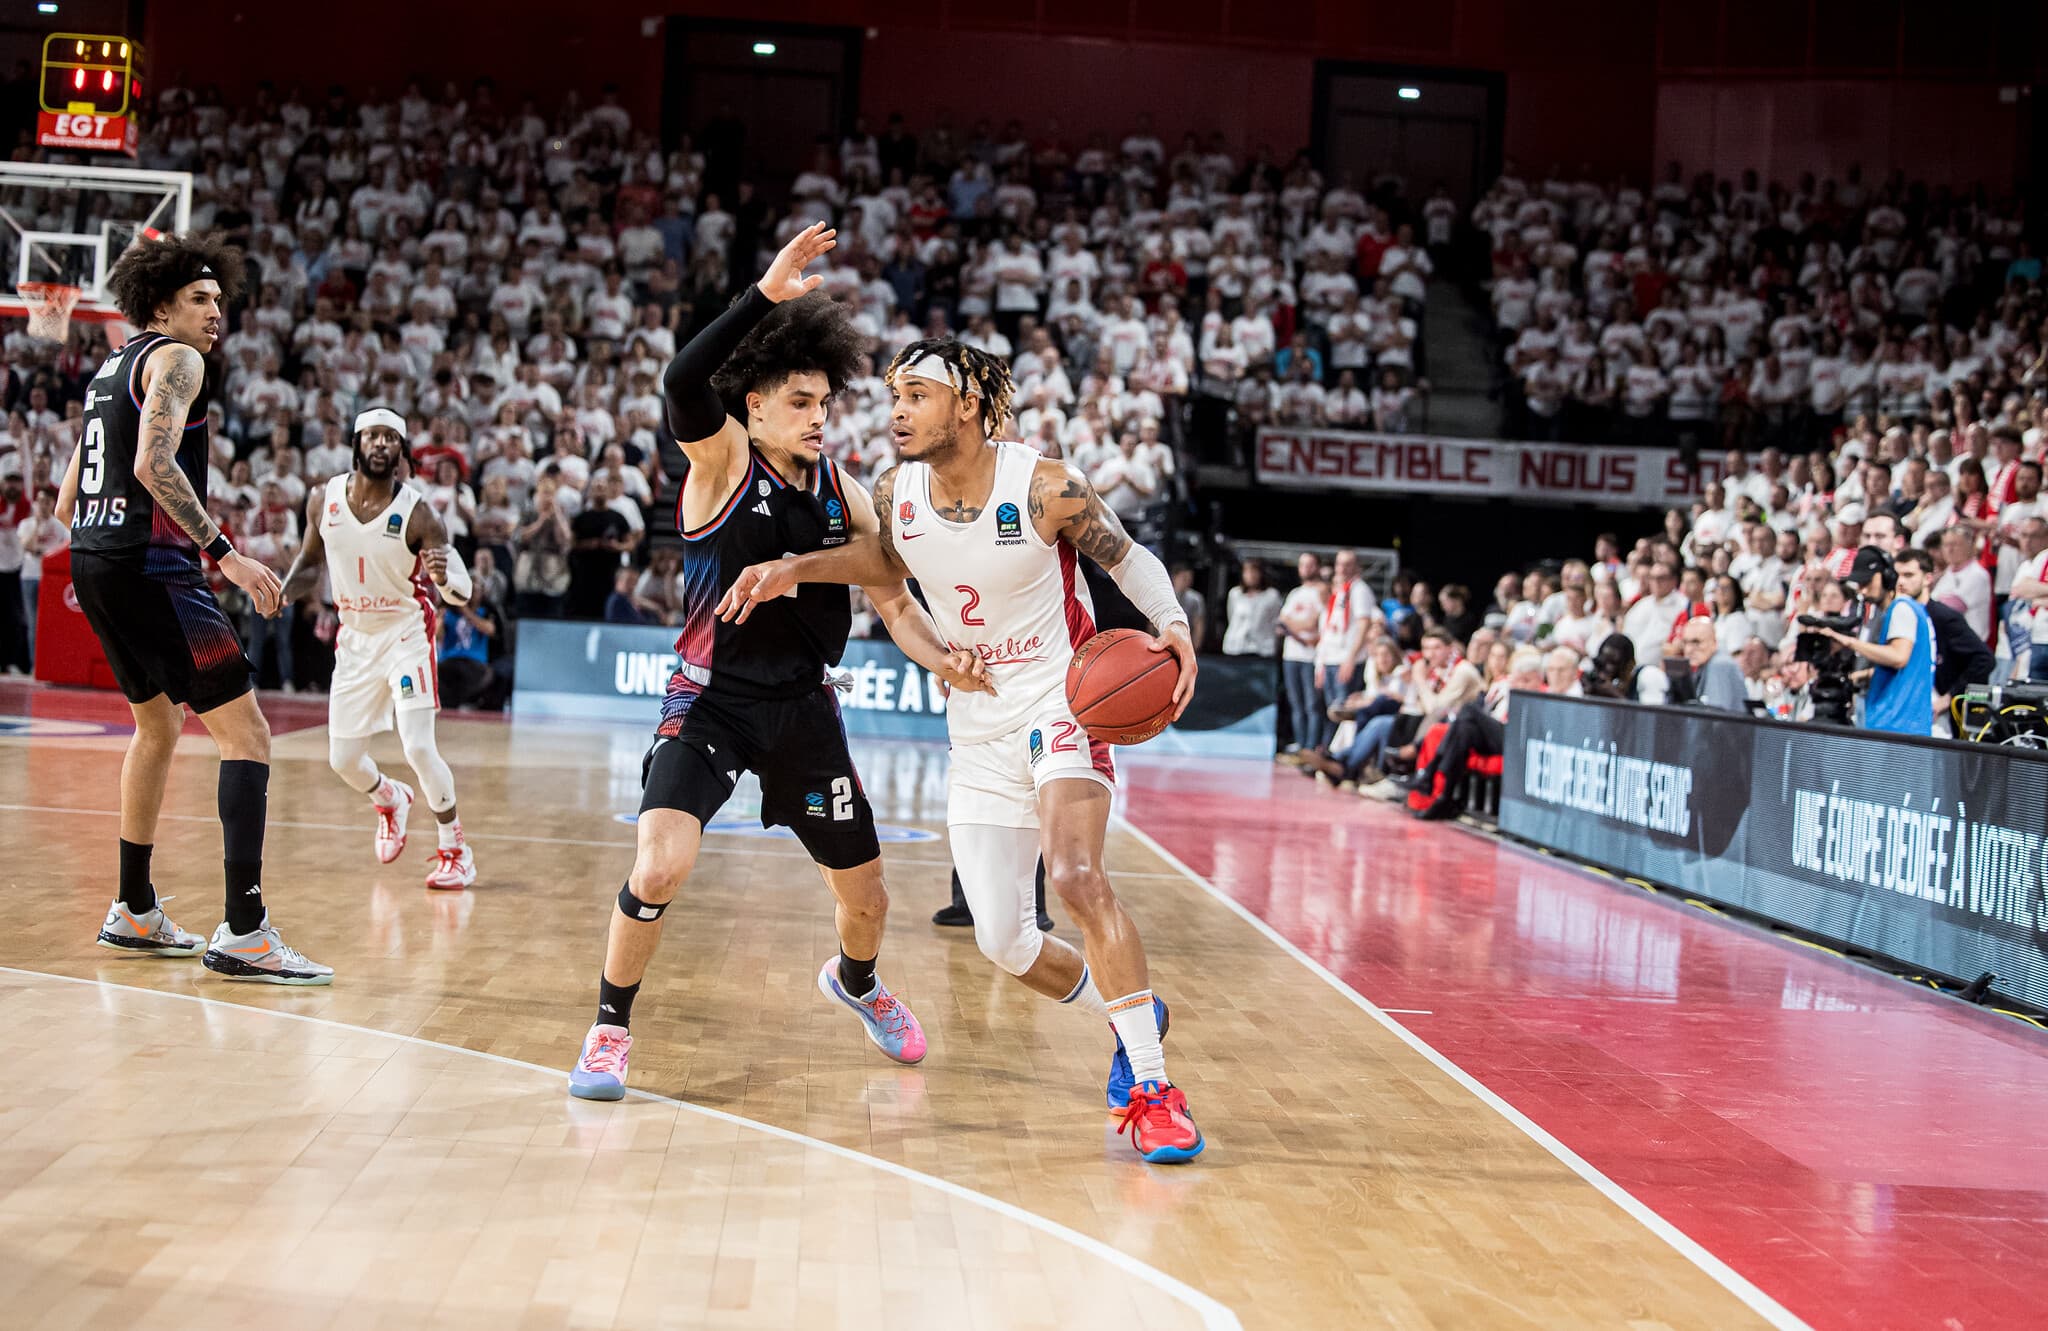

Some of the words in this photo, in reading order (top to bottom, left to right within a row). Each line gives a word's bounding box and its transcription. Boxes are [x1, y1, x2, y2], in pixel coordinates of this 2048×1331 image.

[55, 114, 109, 137] EGT
[81, 417, 105, 494] 3
[1259, 435, 1492, 484] ENSEMBLE
[1520, 450, 1637, 494] NOUS
[71, 497, 127, 529] ARIS
[995, 538, 1028, 546] oneteam
[358, 556, 365, 584] 1
[954, 584, 985, 627] 2
[976, 636, 1043, 660] Délice
[417, 665, 427, 694] 1
[614, 651, 679, 696] UNE
[898, 661, 923, 713] À
[1051, 721, 1079, 753] 2
[831, 776, 854, 821] 2
[1792, 790, 1828, 872] UNE
[1824, 780, 1886, 887] ÉQUIPE
[1883, 792, 1952, 905] DÉDIÉE
[1949, 801, 1967, 909] À
[1969, 821, 2040, 928] VOTRE
